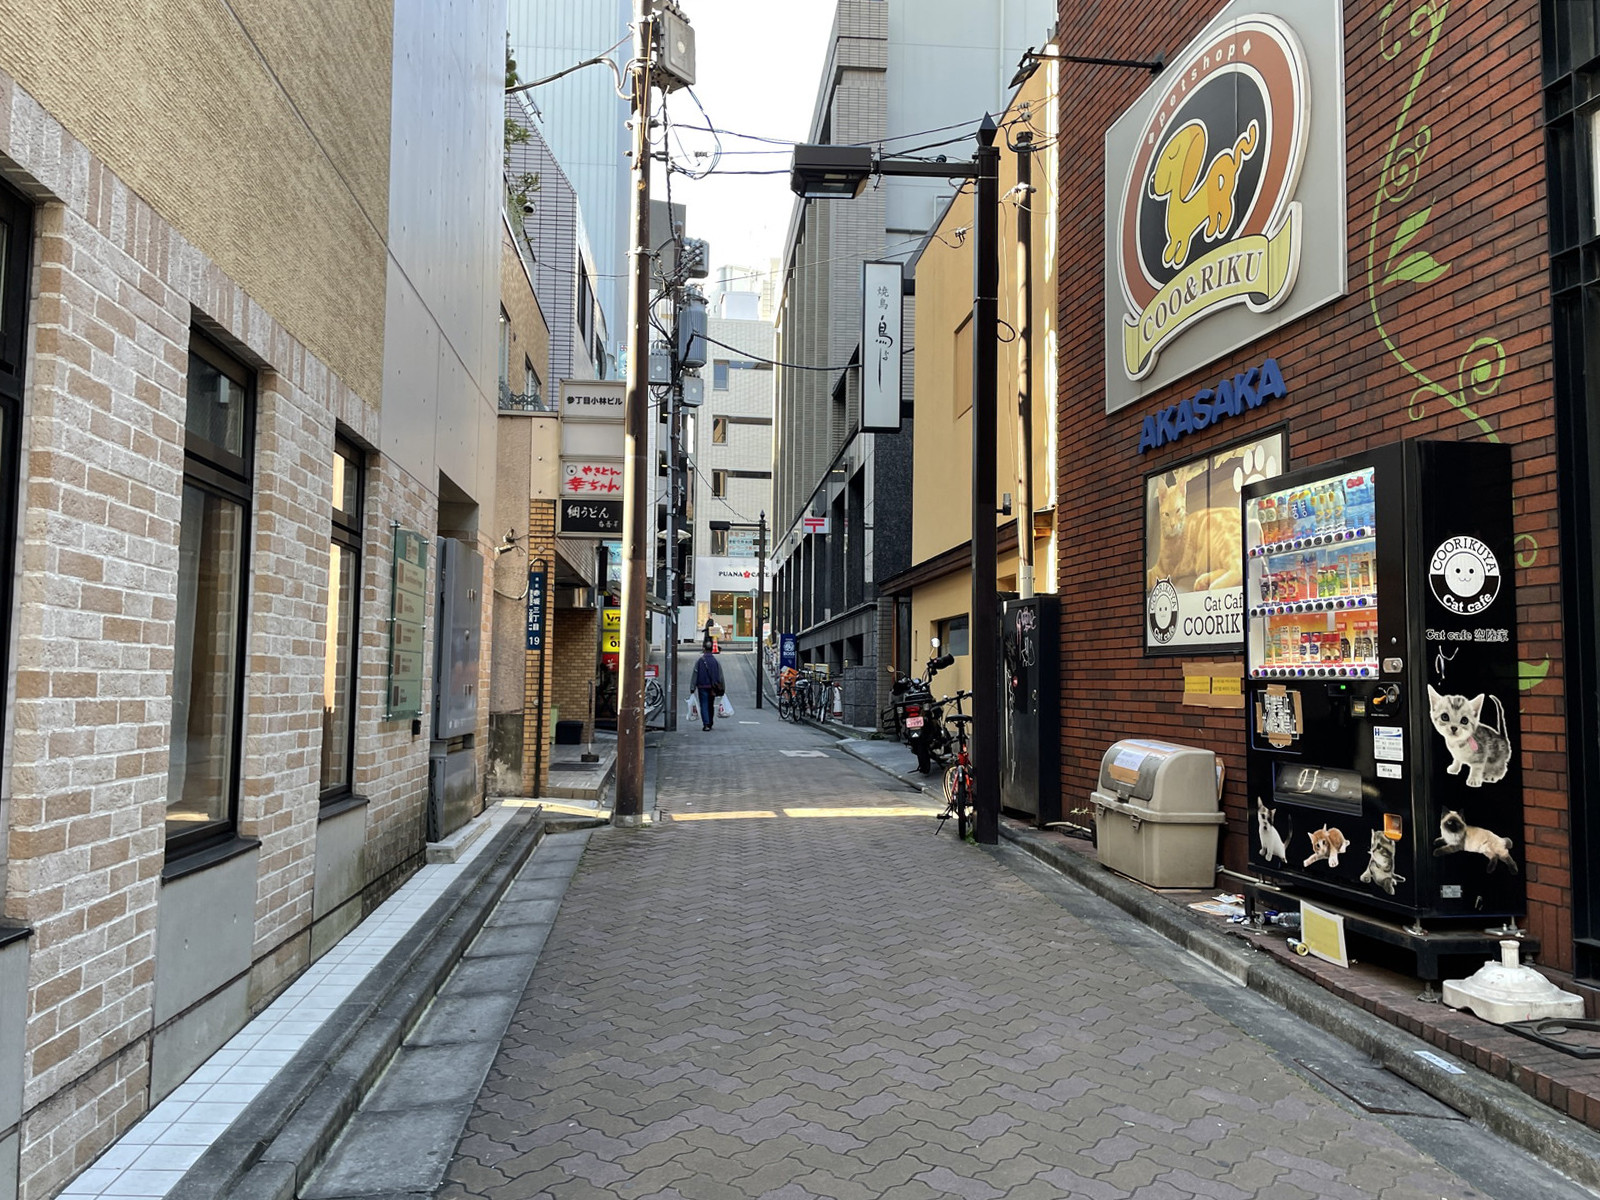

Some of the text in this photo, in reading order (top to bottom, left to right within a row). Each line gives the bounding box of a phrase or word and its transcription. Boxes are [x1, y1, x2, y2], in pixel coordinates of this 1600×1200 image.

[1142, 249, 1265, 344] COO&RIKU
[1138, 358, 1287, 455] AKASAKA
[581, 465, 622, 477] やきとん
[566, 504, 609, 519] 細うどん
[1432, 537, 1497, 573] COORIKUYA
[1204, 596, 1222, 611] Cat
[1443, 593, 1492, 612] Cat cafe
[1184, 613, 1244, 636] COORIK
[528, 636, 540, 646] 19
[1425, 628, 1446, 641] Cat
[1447, 629, 1473, 641] cafe
